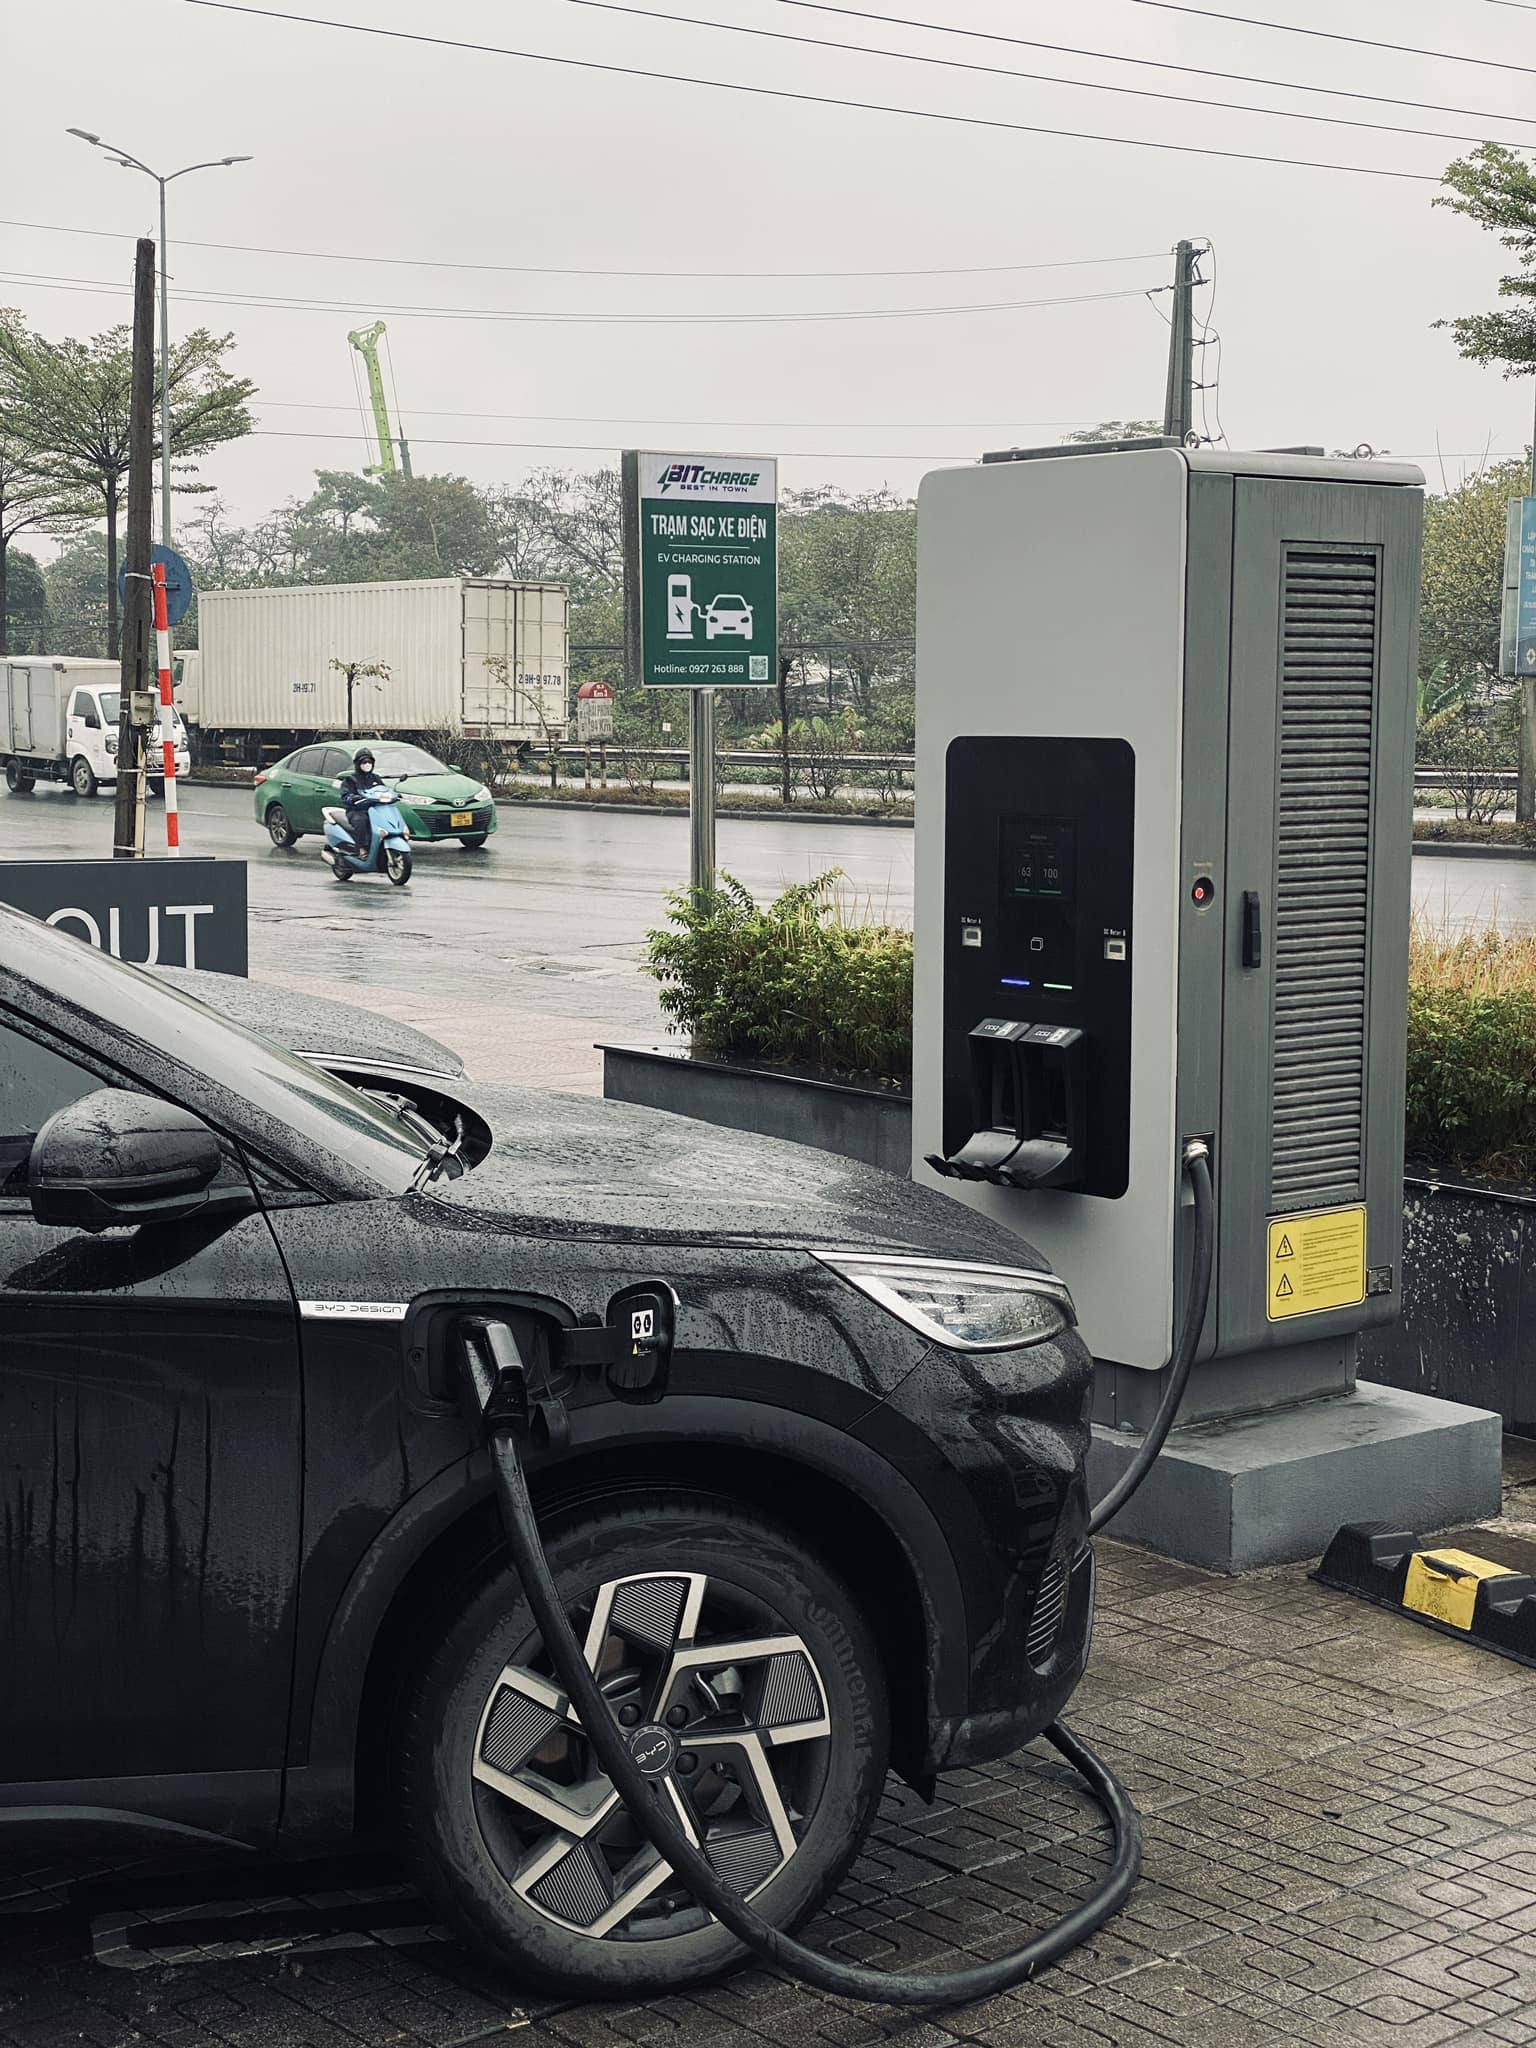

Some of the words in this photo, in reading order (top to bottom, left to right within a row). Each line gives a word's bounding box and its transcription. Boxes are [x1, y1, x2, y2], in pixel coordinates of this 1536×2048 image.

[650, 514, 687, 540] TRẠM
[690, 516, 715, 541] SẠC
[718, 517, 735, 537] XE
[737, 514, 767, 542] ĐIỆN
[657, 553, 670, 562] EV
[672, 553, 721, 564] CHARGING
[722, 555, 760, 565] STATION
[654, 663, 688, 673] Hotline:
[688, 664, 710, 673] 0927
[711, 664, 726, 673] 263
[727, 664, 744, 673] 888
[1043, 868, 1058, 879] 100
[349, 1305, 402, 1313] DESIGN
[634, 1740, 667, 1764] BYD
